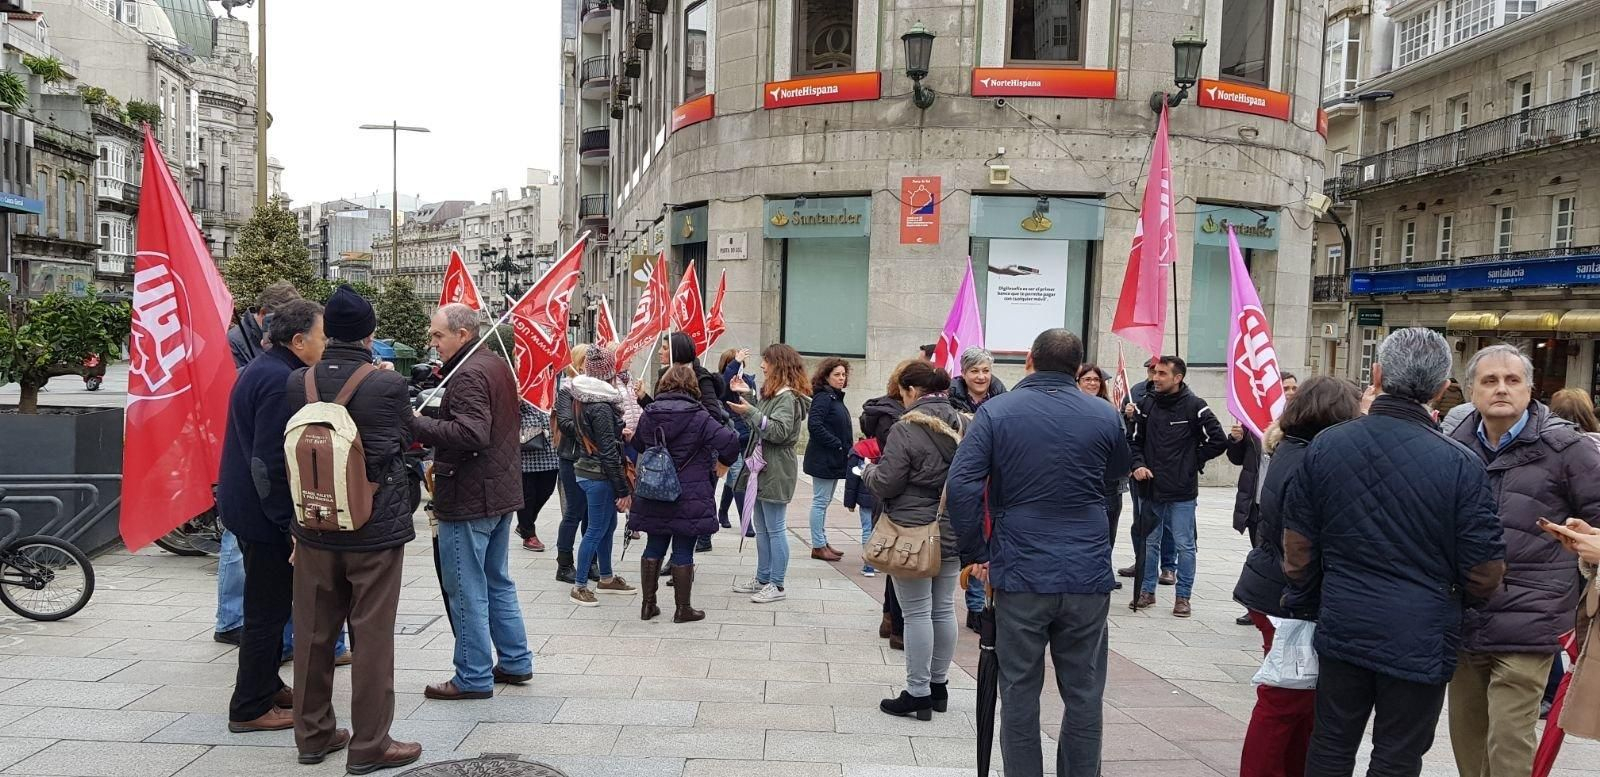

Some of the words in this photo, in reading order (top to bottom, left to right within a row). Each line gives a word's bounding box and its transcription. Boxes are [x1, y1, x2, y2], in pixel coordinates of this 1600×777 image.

[780, 84, 839, 99] NorteHispana
[990, 79, 1042, 88] NorteHispana
[1217, 90, 1266, 108] NorteHispana
[791, 208, 862, 226] Santander
